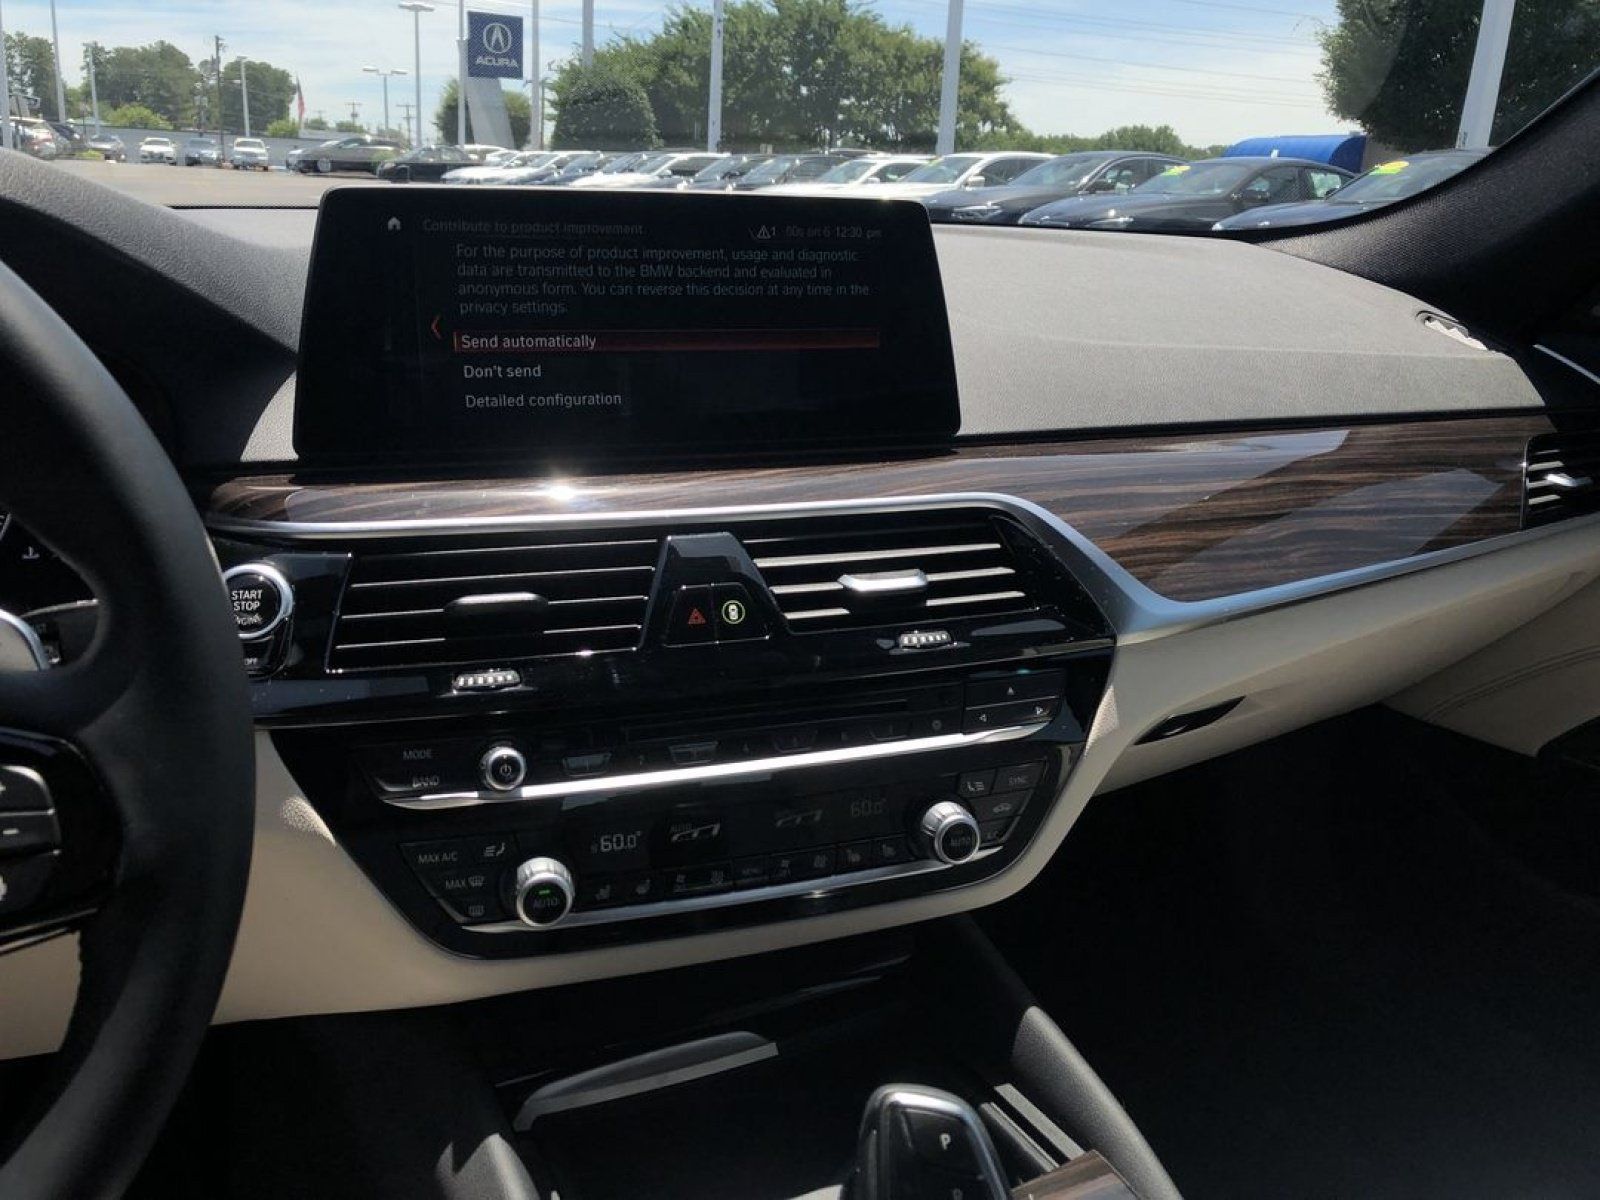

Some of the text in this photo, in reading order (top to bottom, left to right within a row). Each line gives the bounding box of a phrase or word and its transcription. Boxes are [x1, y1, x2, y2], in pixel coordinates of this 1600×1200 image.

[475, 56, 519, 68] ACURA
[422, 218, 643, 237] Contribute to product improvement
[456, 243, 477, 258] For
[482, 244, 506, 258] the
[510, 247, 566, 262] purpose
[570, 245, 584, 259] of
[587, 246, 639, 262] product
[732, 250, 769, 265] usage
[773, 249, 795, 262] and
[798, 249, 859, 265] diagnostic
[457, 262, 832, 279] data are transmitted to the BMW backend and evaluated in
[457, 282, 870, 300] anonymous form. You can reverse this decision at any time in the
[460, 300, 568, 318] privacy settings.
[461, 334, 597, 351] Send automatically
[463, 364, 542, 378] Don't send
[465, 392, 622, 408] Detailed configuration
[231, 589, 263, 601] START
[233, 601, 261, 611] STOP
[402, 748, 433, 761] MODE
[417, 850, 458, 865] MAX A/C
[445, 877, 466, 889] MAX
[939, 1132, 951, 1151] P
